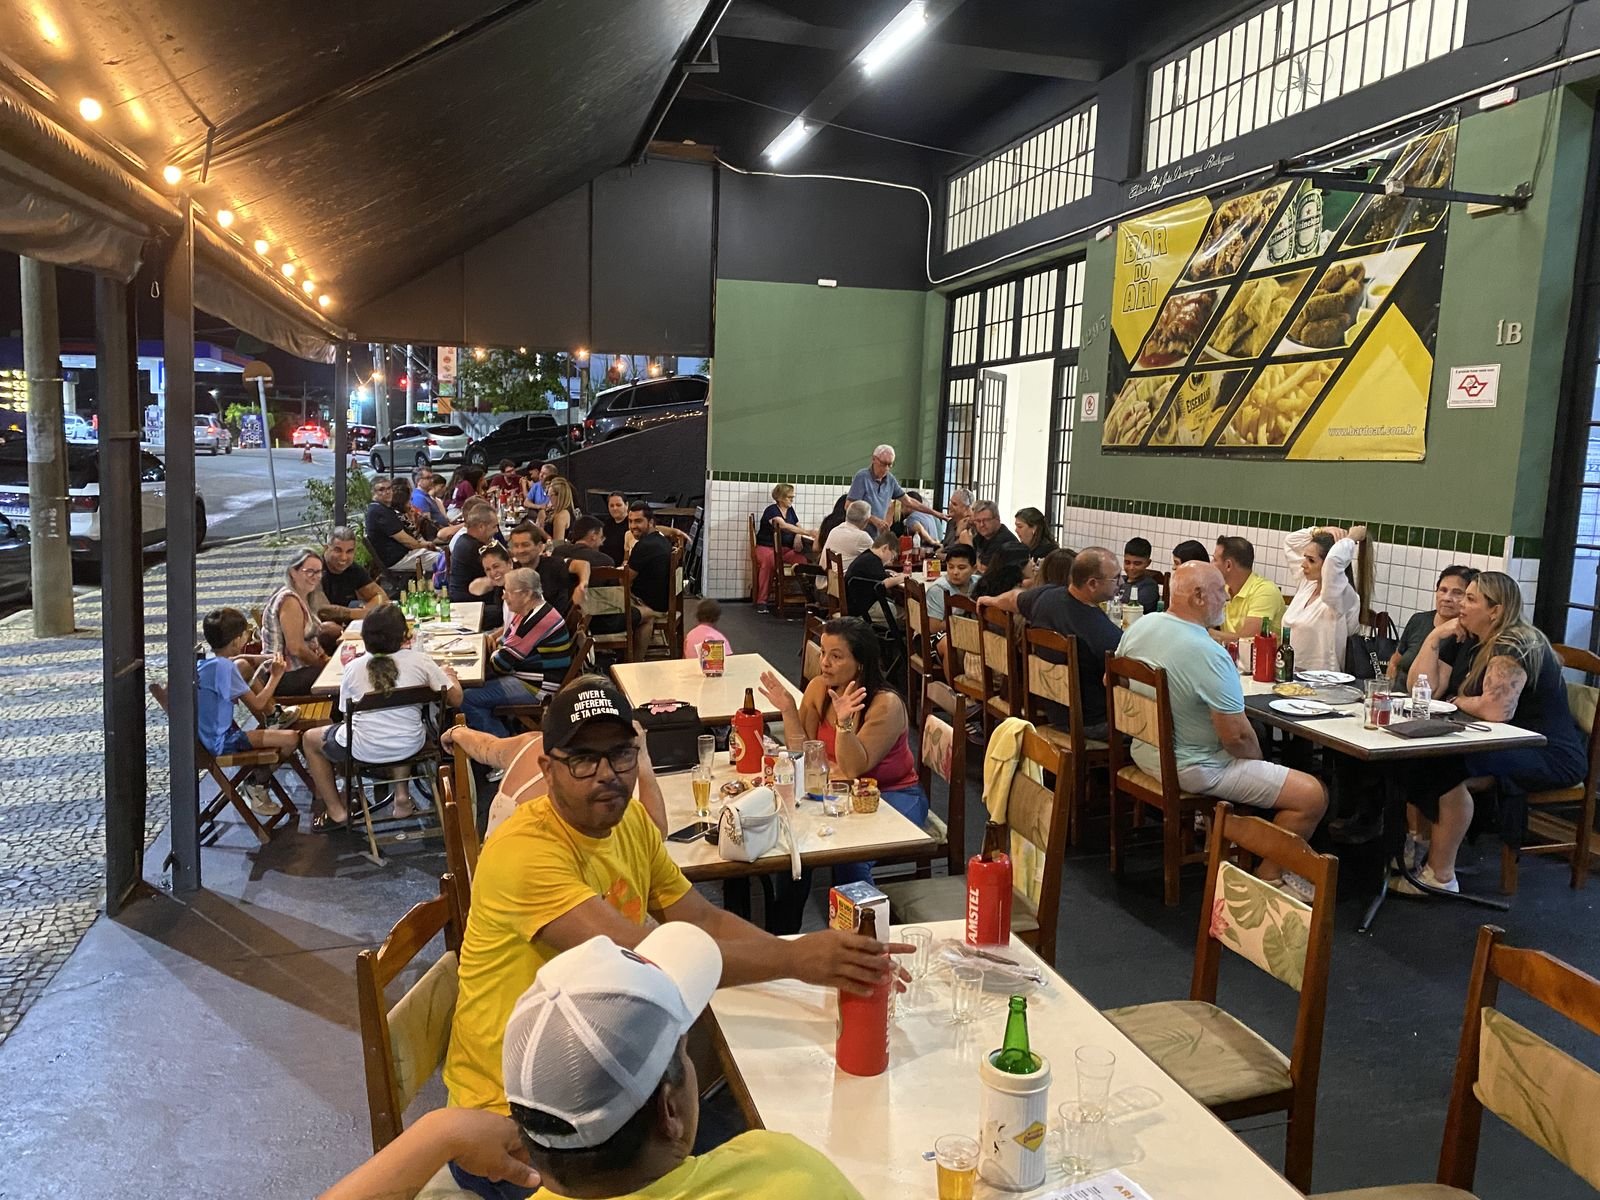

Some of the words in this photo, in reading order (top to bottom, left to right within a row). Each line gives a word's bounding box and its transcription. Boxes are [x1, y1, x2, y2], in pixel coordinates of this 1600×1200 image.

[1124, 226, 1168, 264] BAR
[1134, 261, 1151, 282] DO
[1123, 278, 1158, 313] ARI
[1496, 319, 1522, 346] 1B
[1328, 424, 1417, 436] www.bardoari.com.br
[574, 699, 613, 711] DIFERENTE
[578, 690, 600, 701] VIVER
[570, 712, 581, 723] DE
[581, 709, 591, 718] TA
[968, 885, 979, 944] AMSTEL
